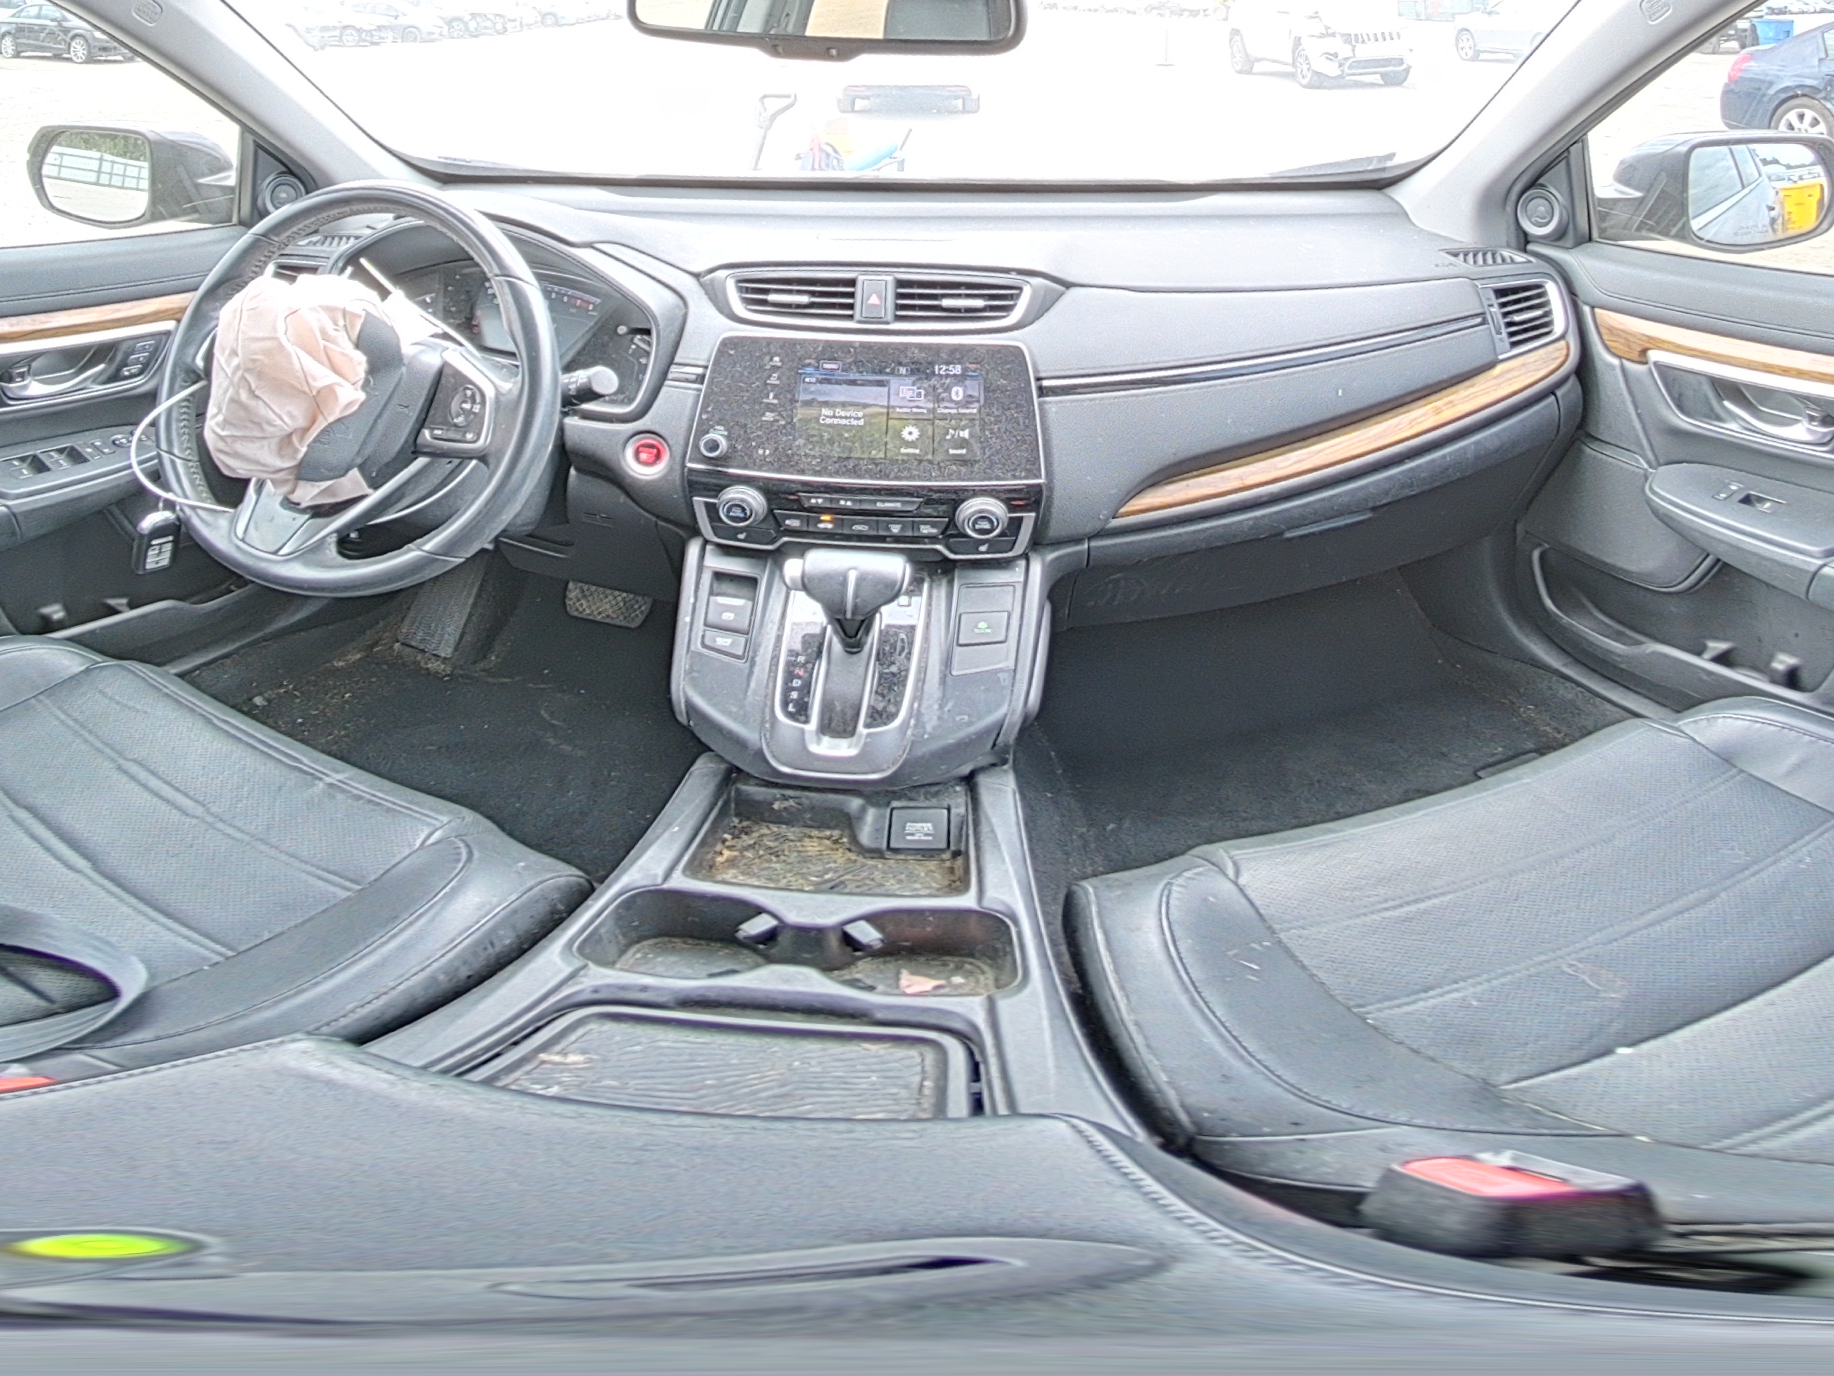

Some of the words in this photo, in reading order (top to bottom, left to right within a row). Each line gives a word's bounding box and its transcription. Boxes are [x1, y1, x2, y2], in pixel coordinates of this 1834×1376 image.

[934, 365, 962, 375] 12:58
[821, 407, 833, 417] No
[835, 408, 864, 418] Device
[819, 416, 865, 426] Connected
[797, 655, 806, 663] R
[792, 679, 801, 687] D
[787, 703, 796, 712] L
